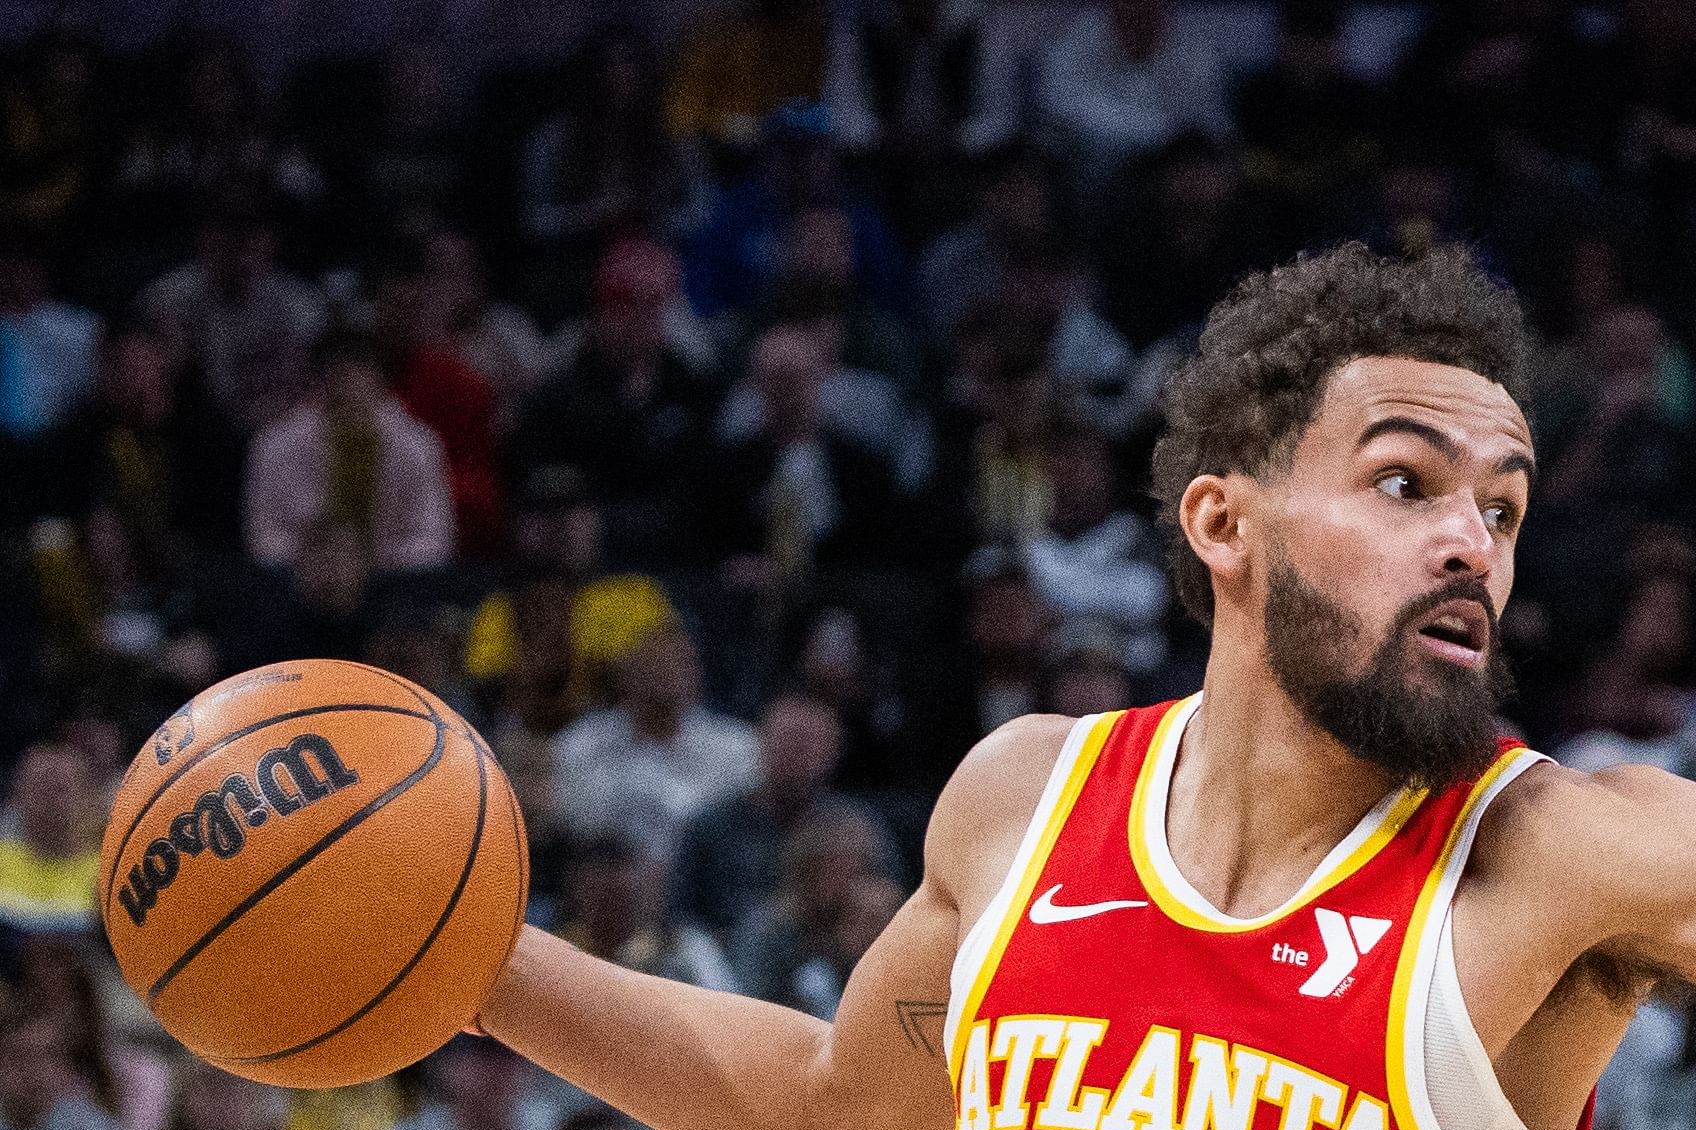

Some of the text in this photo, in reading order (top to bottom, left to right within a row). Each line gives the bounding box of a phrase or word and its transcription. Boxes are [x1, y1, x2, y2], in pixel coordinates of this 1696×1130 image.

[118, 733, 361, 927] Wilson
[1271, 942, 1309, 967] the
[1332, 976, 1356, 998] YMCA
